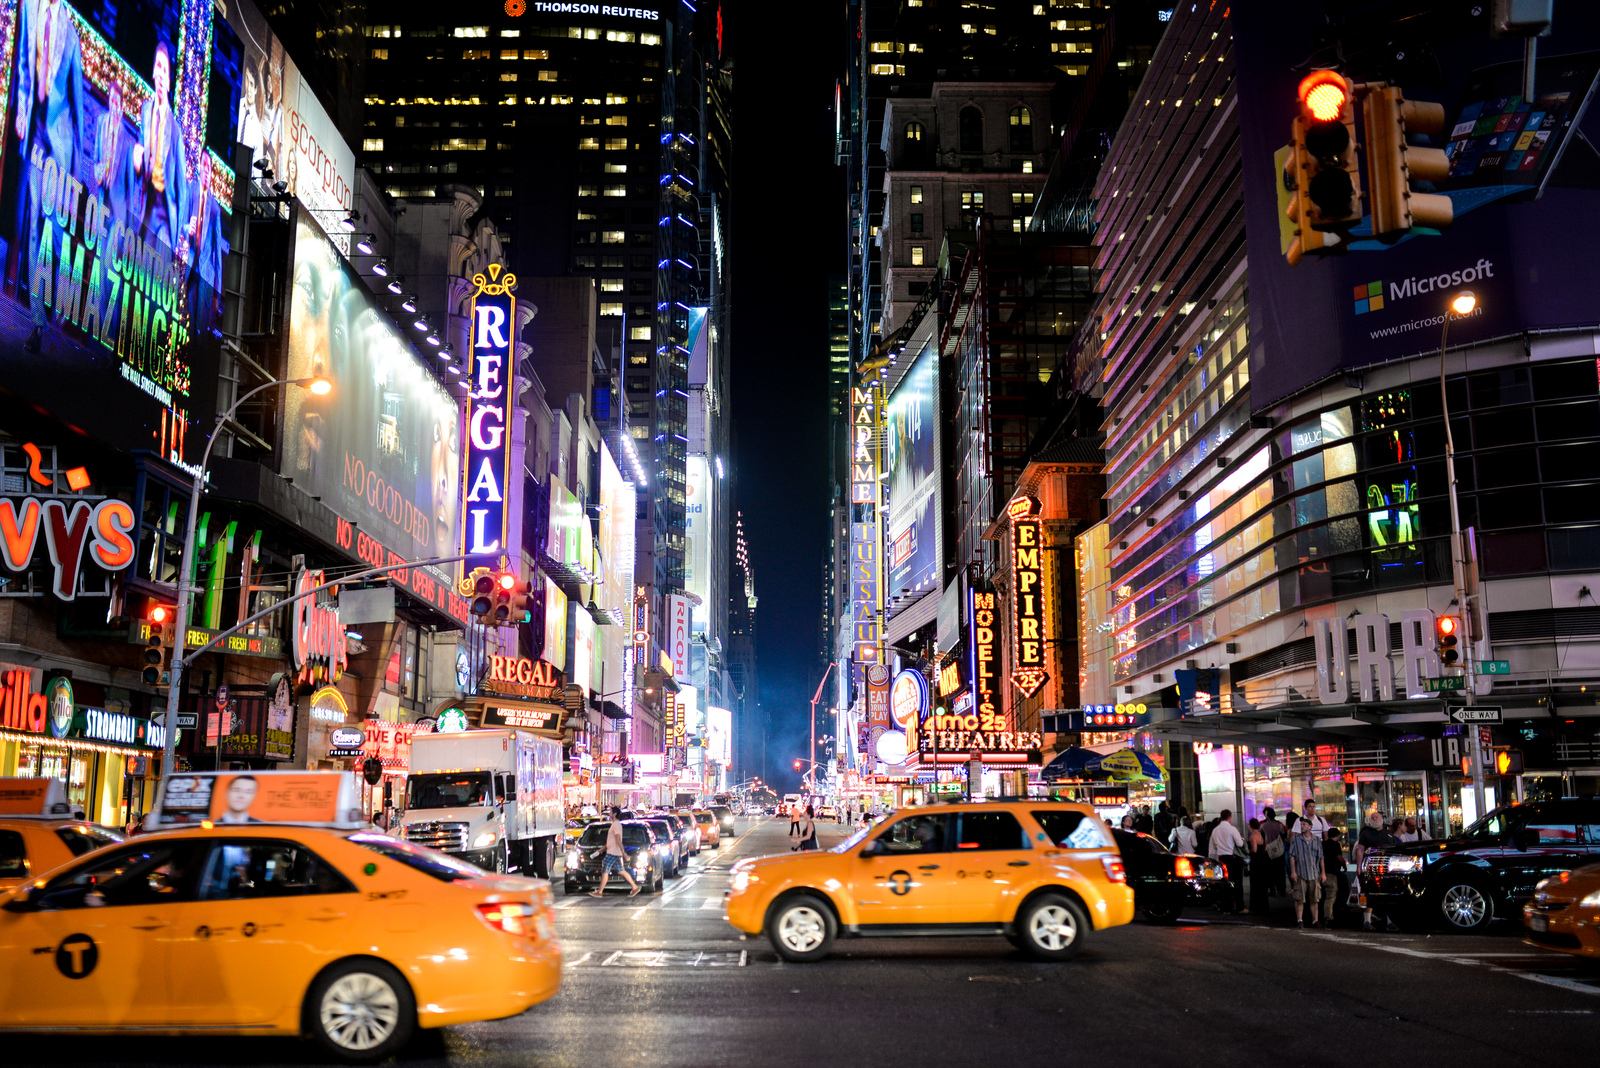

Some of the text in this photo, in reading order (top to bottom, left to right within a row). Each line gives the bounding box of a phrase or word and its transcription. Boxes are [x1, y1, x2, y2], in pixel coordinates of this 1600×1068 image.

[535, 2, 659, 20] THOMSON REUTERS
[84, 193, 112, 257] OF
[1389, 258, 1494, 301] Microsoft
[467, 305, 509, 553] REGAL
[854, 387, 875, 501] MADAME
[343, 450, 430, 547] NO GOOD DEED
[336, 516, 353, 549] NO
[357, 532, 384, 568] GOOD
[387, 552, 409, 586] DEED
[412, 569, 435, 603] OPENS
[1016, 525, 1039, 663] EMPIRE
[188, 629, 209, 646] FRESH
[228, 635, 247, 652] FRESH
[675, 601, 685, 675] RICOH
[490, 655, 558, 687] REGAL
[1489, 663, 1497, 673] 8
[1020, 675, 1037, 687] 25
[1432, 679, 1440, 690] W
[1442, 678, 1454, 689] 42
[870, 690, 888, 703] EAT
[86, 708, 135, 744] STROMBOLI
[179, 717, 193, 725] WAY
[870, 712, 888, 721] PLAY
[923, 715, 1007, 731] amc 25
[1459, 711, 1496, 719] ONE WAY
[923, 731, 1042, 749] THEATRES
